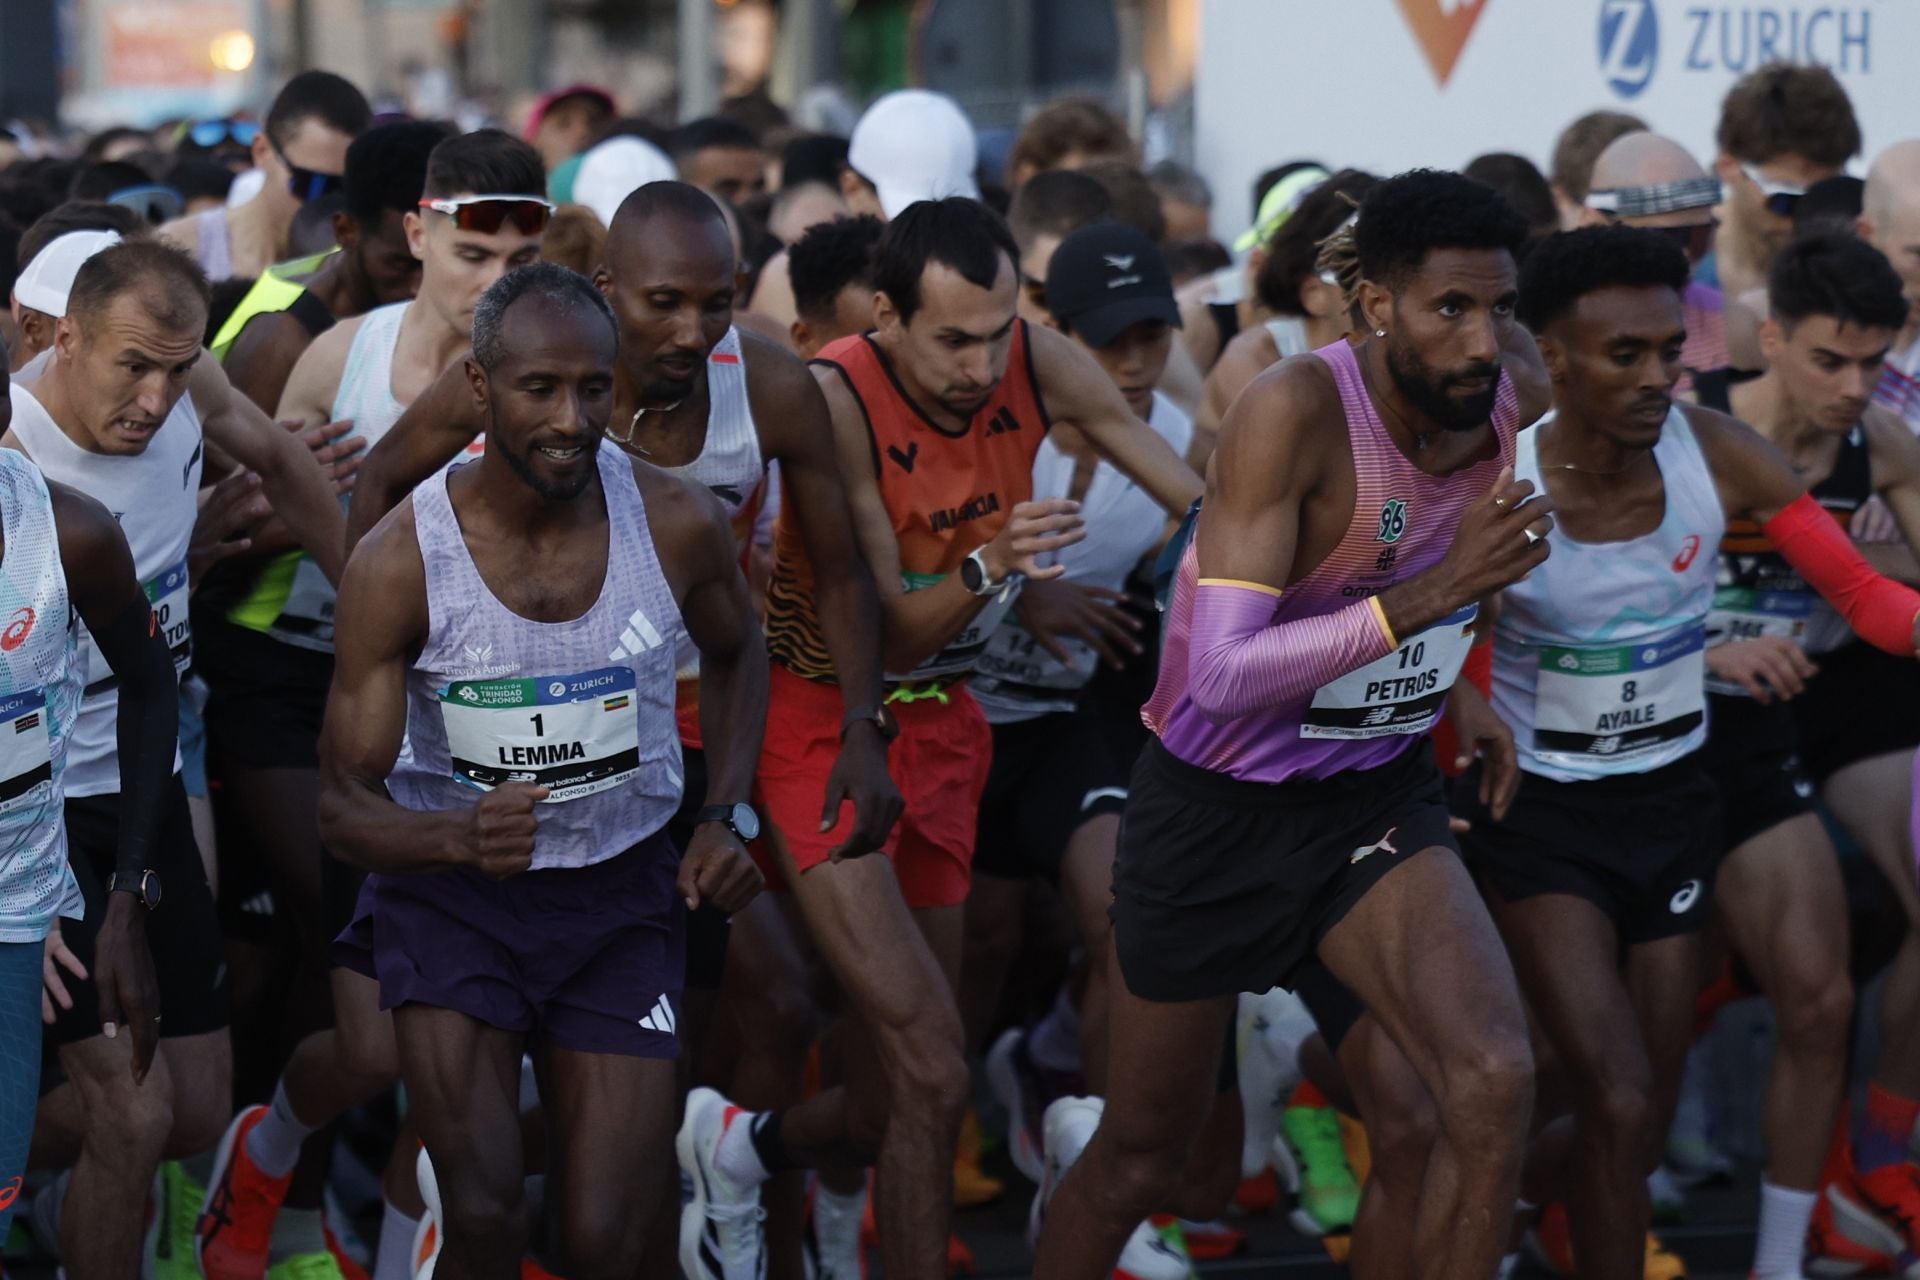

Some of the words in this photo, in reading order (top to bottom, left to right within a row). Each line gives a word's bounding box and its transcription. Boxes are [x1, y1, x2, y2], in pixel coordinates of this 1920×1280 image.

[1684, 8, 1872, 73] ZURICH
[1378, 501, 1408, 540] 96
[1399, 641, 1425, 669] 10
[483, 661, 521, 675] Angels
[480, 689, 522, 698] TRINIDAD
[571, 675, 614, 692] ZURICH
[1364, 669, 1438, 702] PETROS
[1621, 680, 1637, 702] 8
[481, 696, 523, 704] ALFONSO
[530, 713, 544, 737] 1
[1595, 703, 1655, 731] AYALE
[499, 741, 586, 766] LEMMA
[556, 775, 587, 787] balance
[550, 787, 587, 800] ALFONSO
